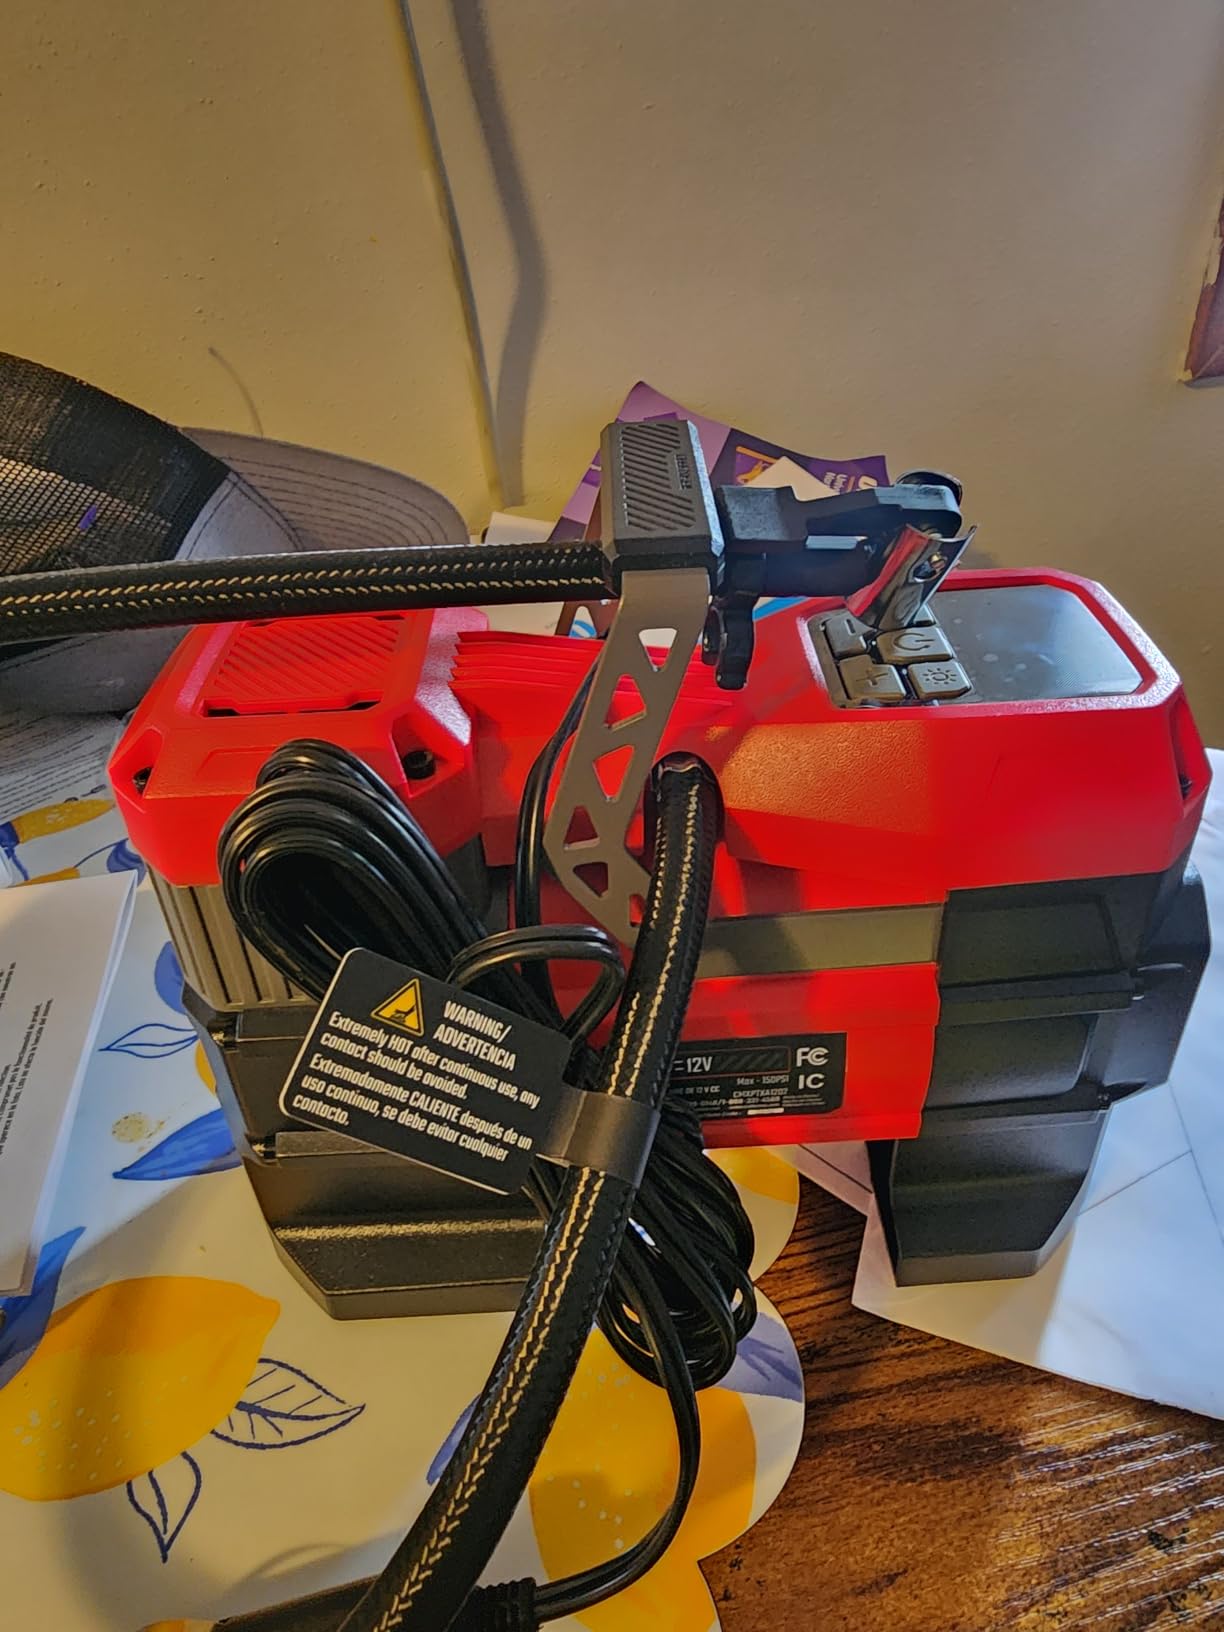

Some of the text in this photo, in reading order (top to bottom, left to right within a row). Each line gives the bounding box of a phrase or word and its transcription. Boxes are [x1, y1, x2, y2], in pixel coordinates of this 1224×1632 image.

[433, 1024, 516, 1071] ADVERTENCIA
[444, 1001, 512, 1044] WARNING/
[320, 1032, 468, 1100] contact should be avoided.
[328, 1011, 540, 1110] Extremely HOT after continuous use, any
[798, 1073, 825, 1090] IC
[293, 1094, 350, 1126] contacto.
[301, 1075, 509, 1162] uso continuo, se debe evitar cualquier
[309, 1052, 532, 1150] Extremadamente CALIENTE después de un
